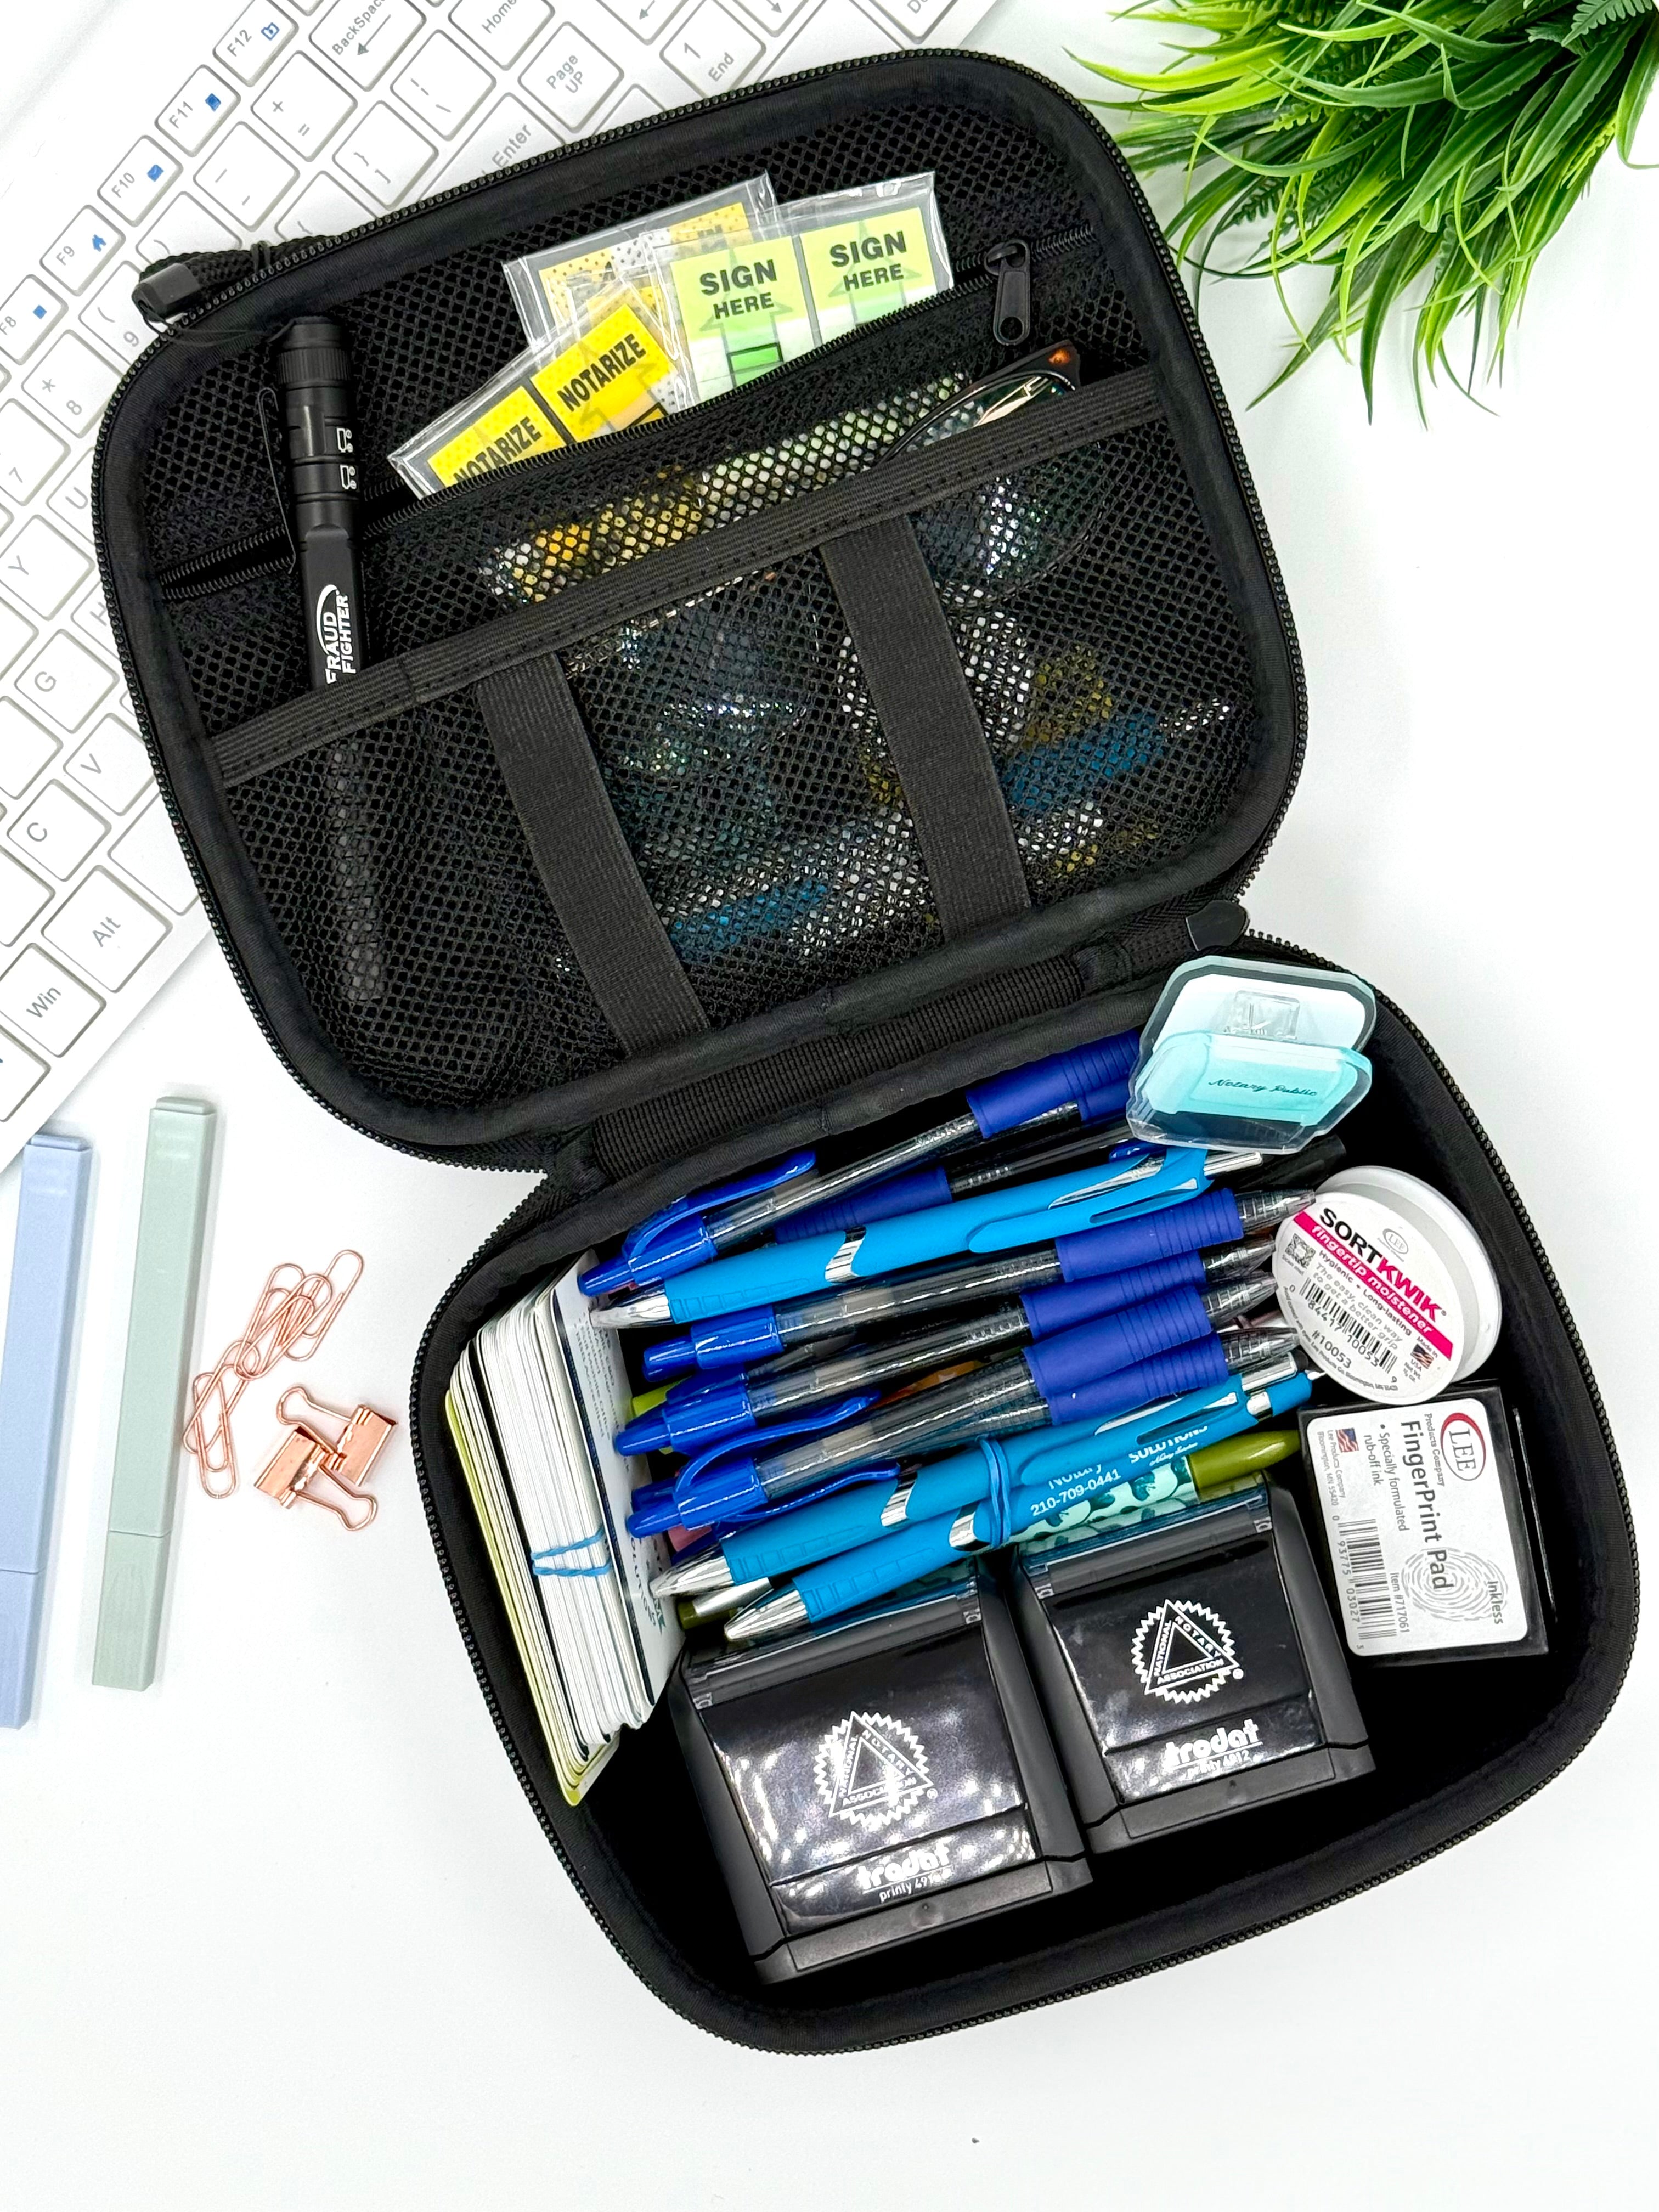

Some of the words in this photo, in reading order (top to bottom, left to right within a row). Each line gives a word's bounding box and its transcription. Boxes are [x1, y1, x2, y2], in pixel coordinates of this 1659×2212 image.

[331, 0, 385, 55] BackSpac
[482, 0, 517, 34] Home
[226, 29, 252, 57] F12
[546, 54, 578, 89] Page
[565, 71, 584, 94] UP
[708, 52, 735, 83] End
[168, 101, 194, 130] F11
[492, 123, 532, 168] Enter
[111, 172, 135, 198] F10
[56, 246, 75, 266] F9
[830, 230, 907, 268] SIGN
[699, 259, 777, 297] SIGN
[843, 263, 904, 292] HERE
[713, 292, 774, 320] HERE
[123, 331, 139, 347] 9
[556, 333, 646, 412] NOTARIZE
[66, 400, 82, 415] 8
[453, 416, 543, 484] NOTARIZE
[9, 467, 22, 483] 7
[65, 486, 89, 510] U
[8, 555, 29, 575] Y
[323, 612, 341, 685] FRAUD
[336, 595, 357, 674] FIGHTER
[35, 672, 57, 692] G
[80, 753, 102, 774] V
[27, 822, 47, 842] C
[92, 917, 121, 947] Alt
[26, 988, 61, 1018] Win
[1209, 1080, 1267, 1092] Notary
[1269, 1086, 1317, 1096] Public
[1311, 1225, 1367, 1277] fingertip
[1367, 1276, 1434, 1334] moistener
[1319, 1250, 1353, 1283] Hygienic
[1363, 1289, 1412, 1336] Long-lasting
[1313, 1272, 1323, 1283] to
[1324, 1284, 1341, 1299] get
[1348, 1304, 1378, 1330] better
[1378, 1330, 1397, 1350] grip
[1316, 1262, 1333, 1280] The
[1358, 1302, 1382, 1324] clean
[1384, 1325, 1403, 1341] way
[1307, 1300, 1343, 1334] 84417
[1344, 1333, 1381, 1368] 10053
[1313, 1330, 1351, 1368] #10053
[1364, 1435, 1381, 1467] rub-off
[1424, 1413, 1437, 1447] Products
[1432, 1449, 1445, 1487] Company
[1449, 1428, 1476, 1472] LEE
[1327, 1473, 1334, 1484] MN
[1330, 1442, 1340, 1468] Products
[1335, 1470, 1346, 1498] Company
[1372, 1471, 1384, 1486] ink
[1378, 1432, 1397, 1474] Specially
[1389, 1477, 1410, 1531] formulated
[1031, 1469, 1121, 1516] 210-709-0441
[1401, 1421, 1442, 1543] FingerPrint
[1426, 1549, 1454, 1590] Pad
[631, 1537, 656, 1627] OLUTIONS
[1338, 1540, 1351, 1576] 93775
[1346, 1587, 1361, 1624] 03027
[1390, 1572, 1402, 1592] Item
[1394, 1595, 1410, 1633] #717061
[1486, 1579, 1504, 1624] Inkless
[1153, 1620, 1172, 1677] NATIONAL
[1175, 1616, 1222, 1658] NOTARY
[1157, 1658, 1224, 1685] ASSOCIATION
[861, 1729, 914, 1776] NOTARY
[1164, 1718, 1260, 1767] trodat
[857, 1838, 950, 1891] trodat
[879, 1882, 912, 1903] printy
